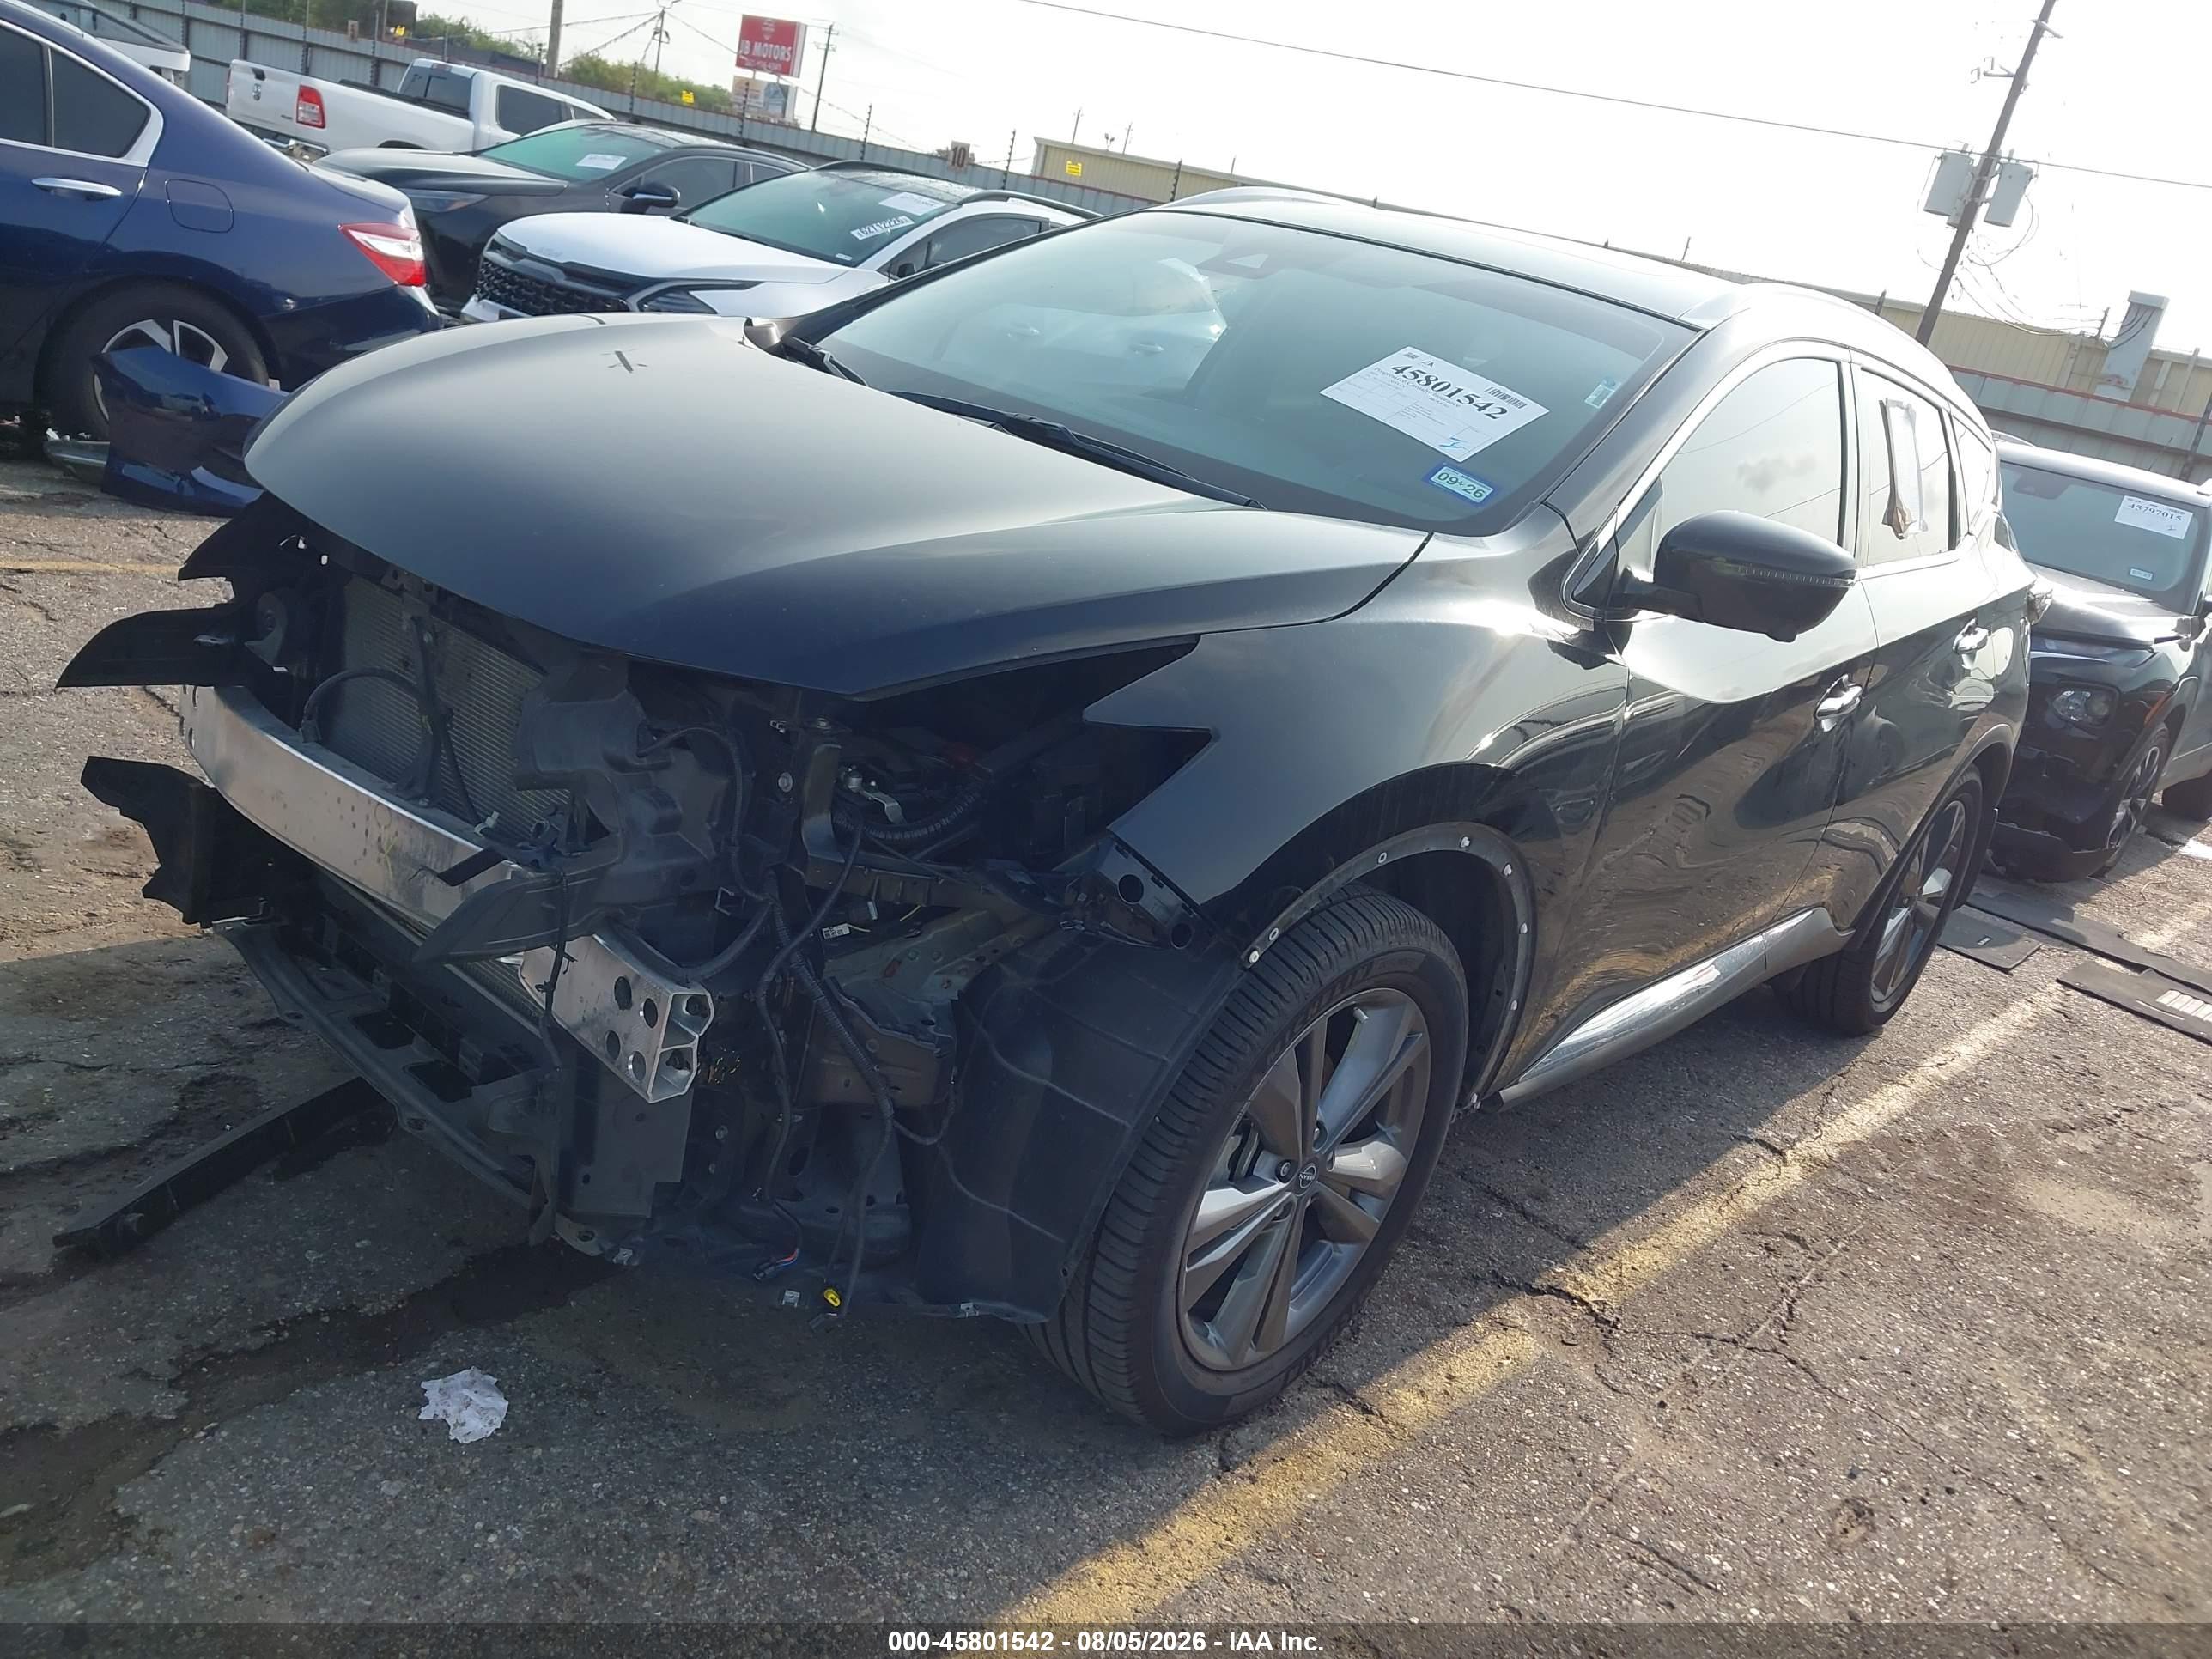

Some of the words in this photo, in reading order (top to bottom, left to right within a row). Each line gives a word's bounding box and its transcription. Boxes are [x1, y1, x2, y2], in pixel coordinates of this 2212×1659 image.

[752, 41, 792, 62] MOTORS
[951, 146, 967, 167] 10
[1391, 365, 1508, 420] 45801542
[1437, 472, 1459, 485] 09
[1462, 484, 1486, 498] 26
[2128, 503, 2183, 521] 45797015
